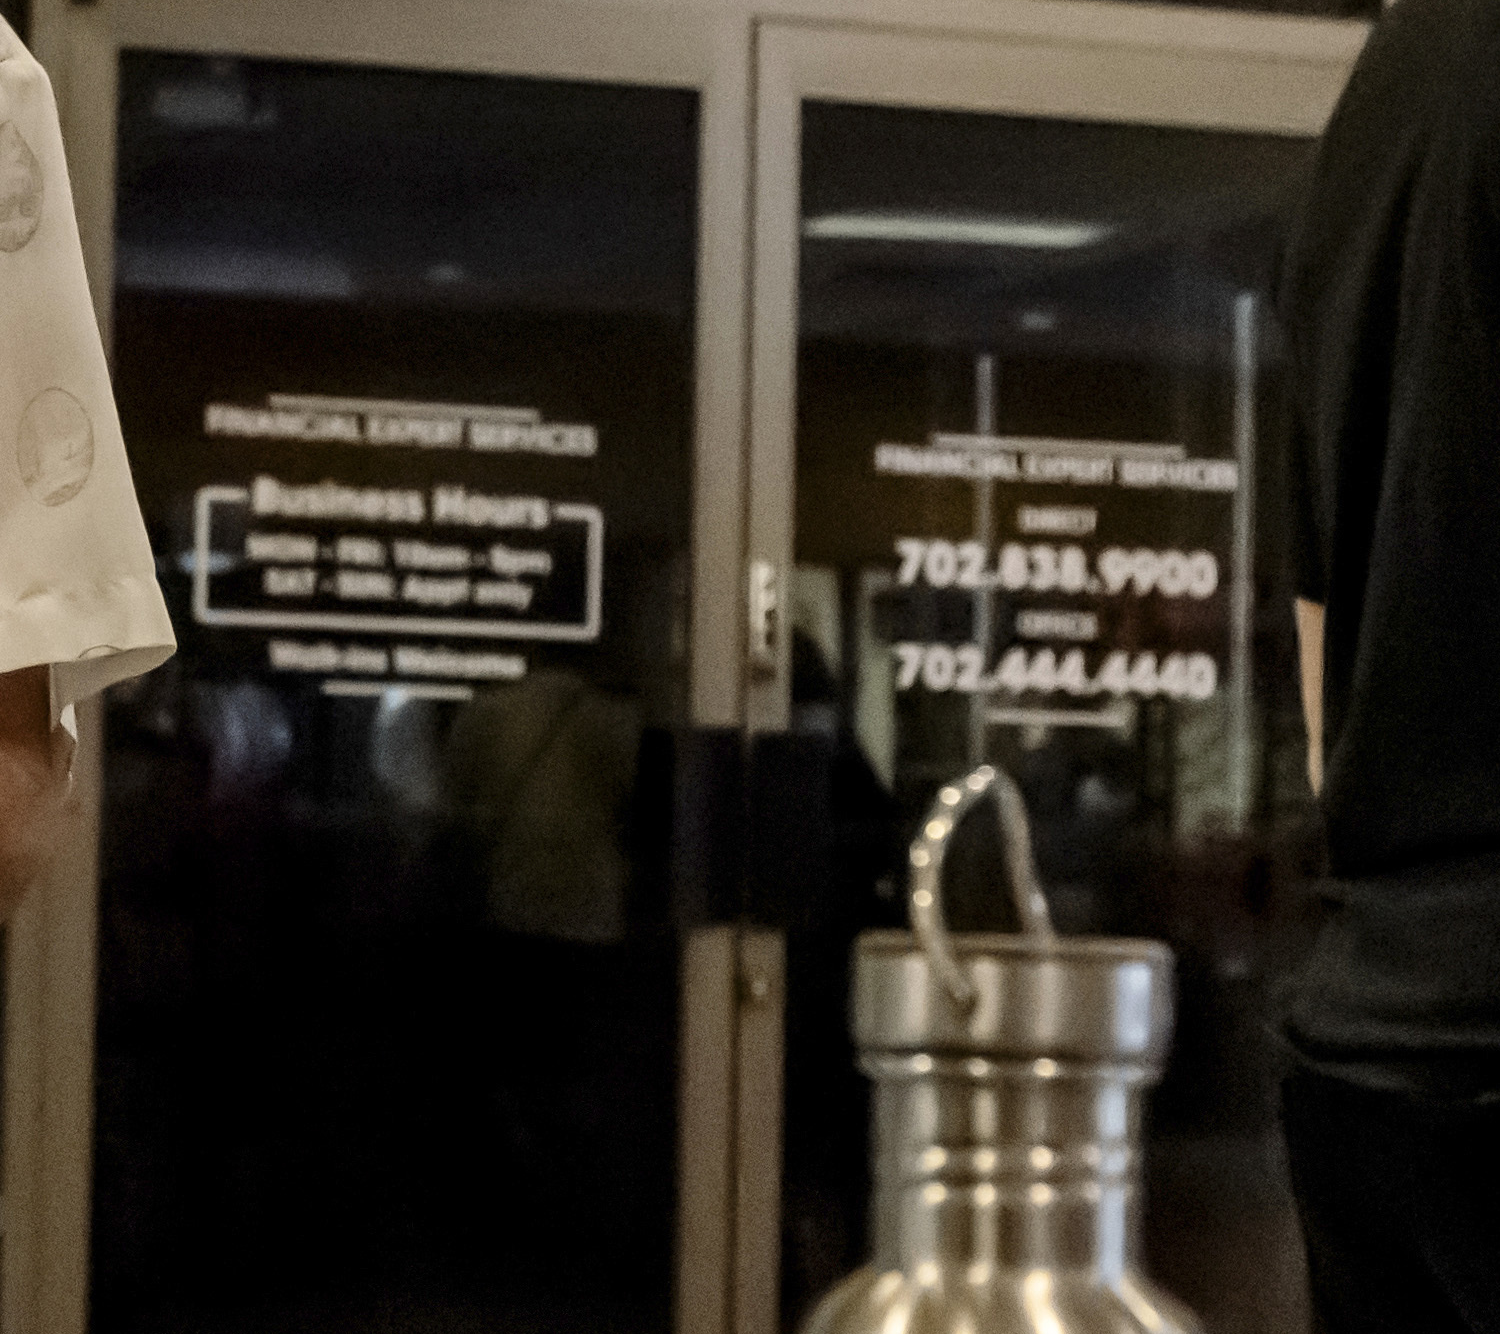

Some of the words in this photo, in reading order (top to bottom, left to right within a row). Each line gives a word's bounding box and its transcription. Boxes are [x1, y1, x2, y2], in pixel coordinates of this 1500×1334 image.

[251, 474, 425, 523] Business
[431, 483, 550, 530] Hours
[894, 535, 1220, 600] 702.838.9900
